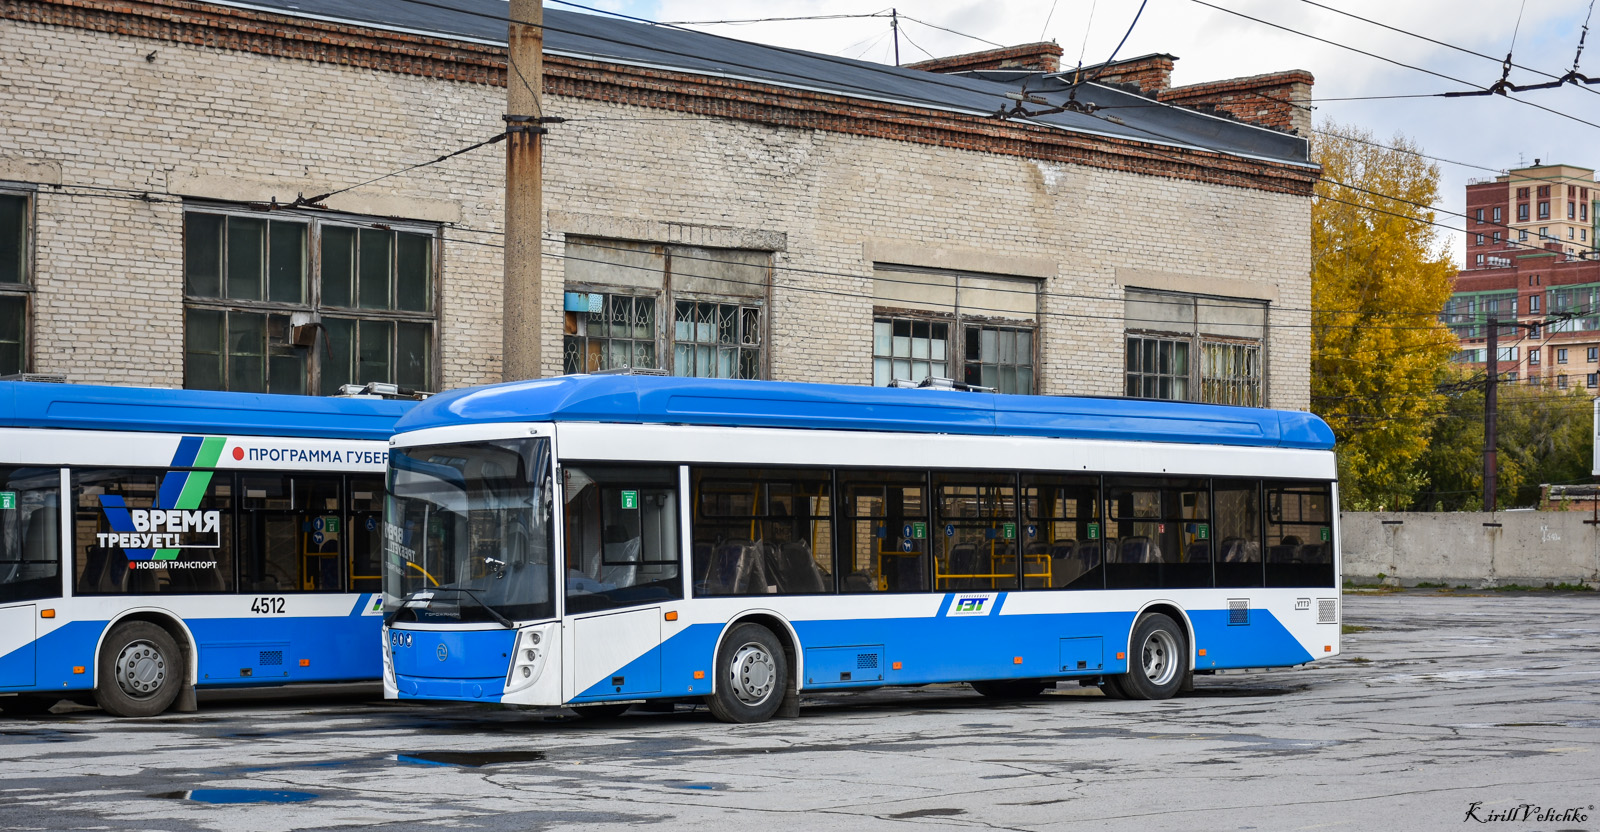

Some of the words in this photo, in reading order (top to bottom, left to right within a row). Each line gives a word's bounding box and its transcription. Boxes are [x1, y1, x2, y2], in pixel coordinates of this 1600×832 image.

[249, 447, 342, 463] ПРОГРАММА
[346, 451, 389, 464] ГУБЕР
[131, 509, 220, 533] ВРЕМЯ
[96, 533, 181, 549] ТРЕБУЕТ!
[136, 560, 168, 570] НОВЫЙ
[168, 561, 217, 570] ТРАНСПОРТ
[251, 597, 286, 614] 4512
